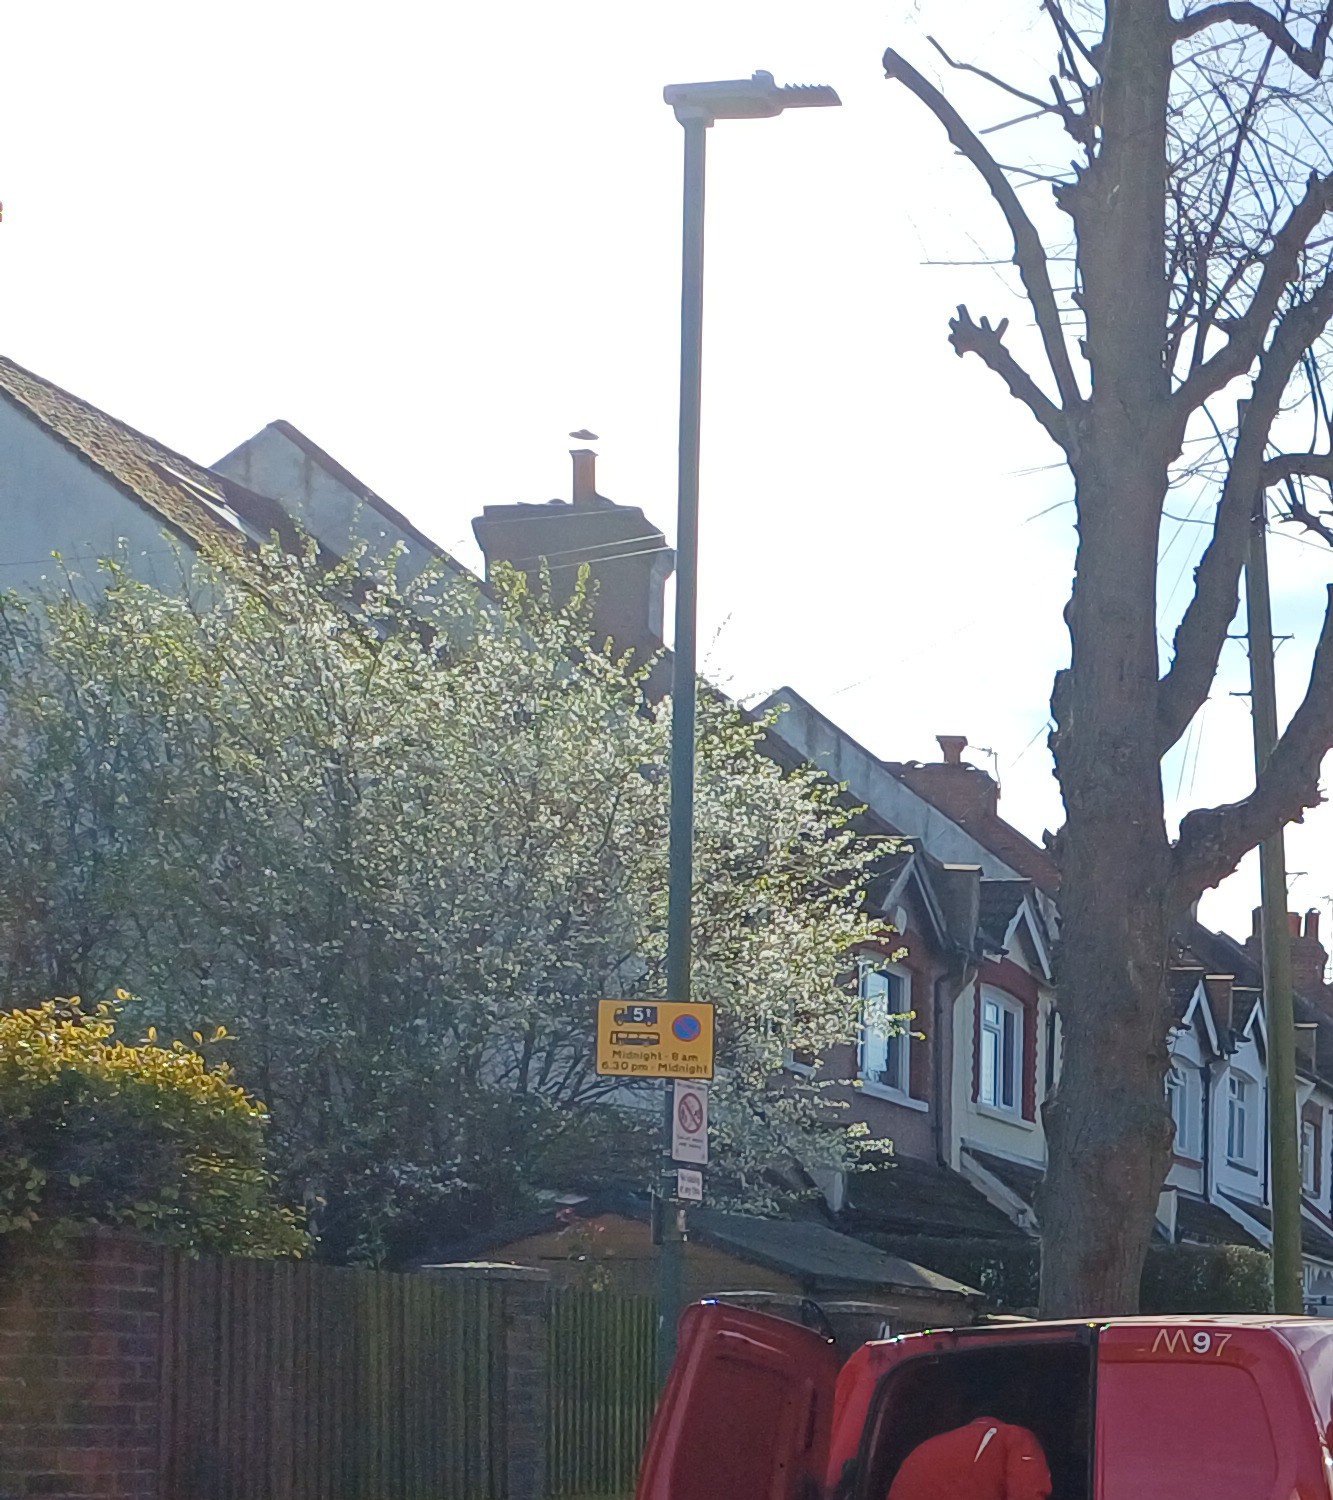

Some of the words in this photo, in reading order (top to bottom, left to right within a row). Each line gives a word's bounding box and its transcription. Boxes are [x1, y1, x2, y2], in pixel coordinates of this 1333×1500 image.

[612, 1050, 662, 1061] Midnight
[682, 1054, 698, 1062] am
[602, 1061, 629, 1070] 6.30
[631, 1063, 649, 1072] pm
[657, 1063, 708, 1075] Midnight
[1151, 1328, 1233, 1357] M97
